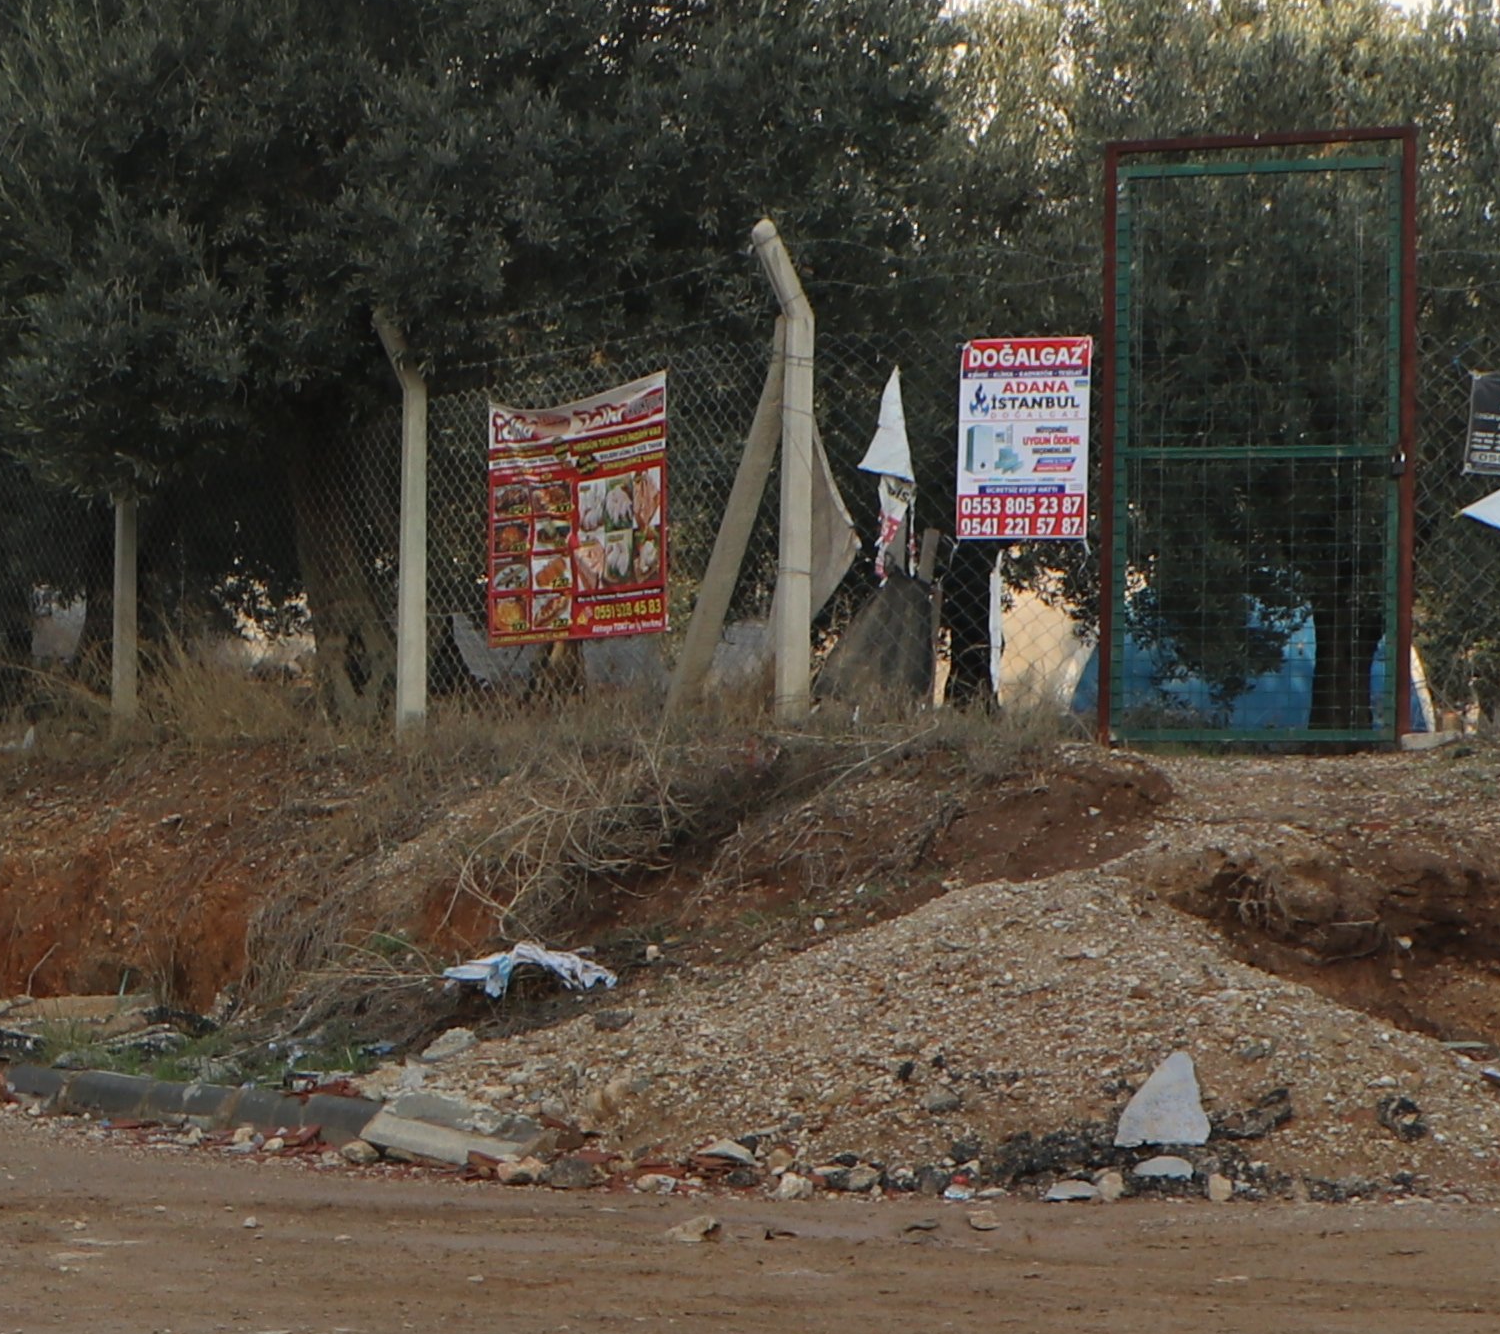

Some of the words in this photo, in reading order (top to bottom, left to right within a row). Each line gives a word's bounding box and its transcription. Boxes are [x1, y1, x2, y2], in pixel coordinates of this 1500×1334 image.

[969, 344, 1083, 367] DOĞALGAZ
[1002, 380, 1069, 394] ADANA
[991, 394, 1080, 410] İSTANBUL
[1022, 436, 1051, 446] UYGUN
[961, 497, 1001, 515] 0553
[1005, 497, 1035, 514] 805
[1039, 497, 1058, 514] 23
[1062, 496, 1081, 514] 87
[961, 516, 998, 535] 0541
[1004, 517, 1030, 535] 221
[1036, 517, 1056, 535] 57
[1061, 516, 1081, 535] 87
[634, 600, 646, 615] 45
[648, 598, 661, 614] 83
